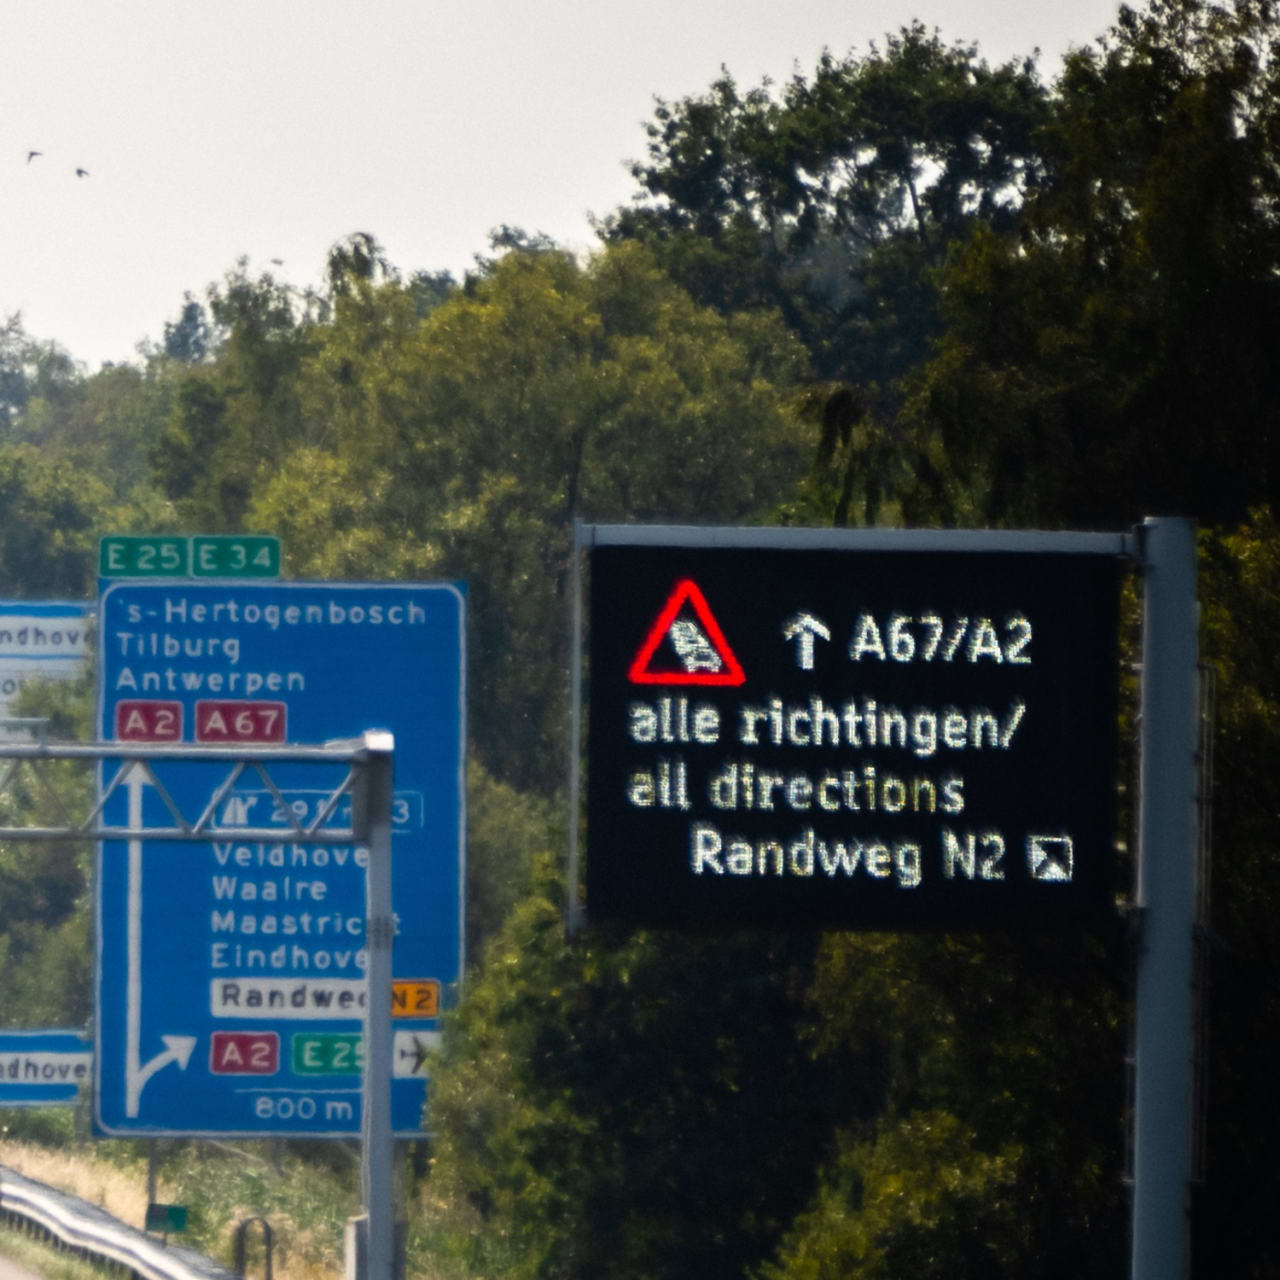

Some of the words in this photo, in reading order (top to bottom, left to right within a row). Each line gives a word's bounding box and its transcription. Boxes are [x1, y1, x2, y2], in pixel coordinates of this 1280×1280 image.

[118, 599, 427, 632] 's-Hertogenbosch
[116, 630, 241, 662] Tilburg
[848, 611, 1034, 664] A67/A2
[115, 666, 306, 697] Antwerpen
[628, 697, 721, 744] alle
[738, 697, 1026, 759] richtingen/
[627, 760, 692, 811] all
[708, 761, 965, 813] directions
[212, 842, 371, 867] Veldhove
[690, 821, 923, 889] Randweg
[942, 830, 1006, 880] N2
[212, 876, 329, 903] Waalre
[211, 910, 402, 937] Maastrict
[211, 943, 369, 970] Eindhove
[254, 1095, 318, 1120] 800
[325, 1099, 353, 1120] m
